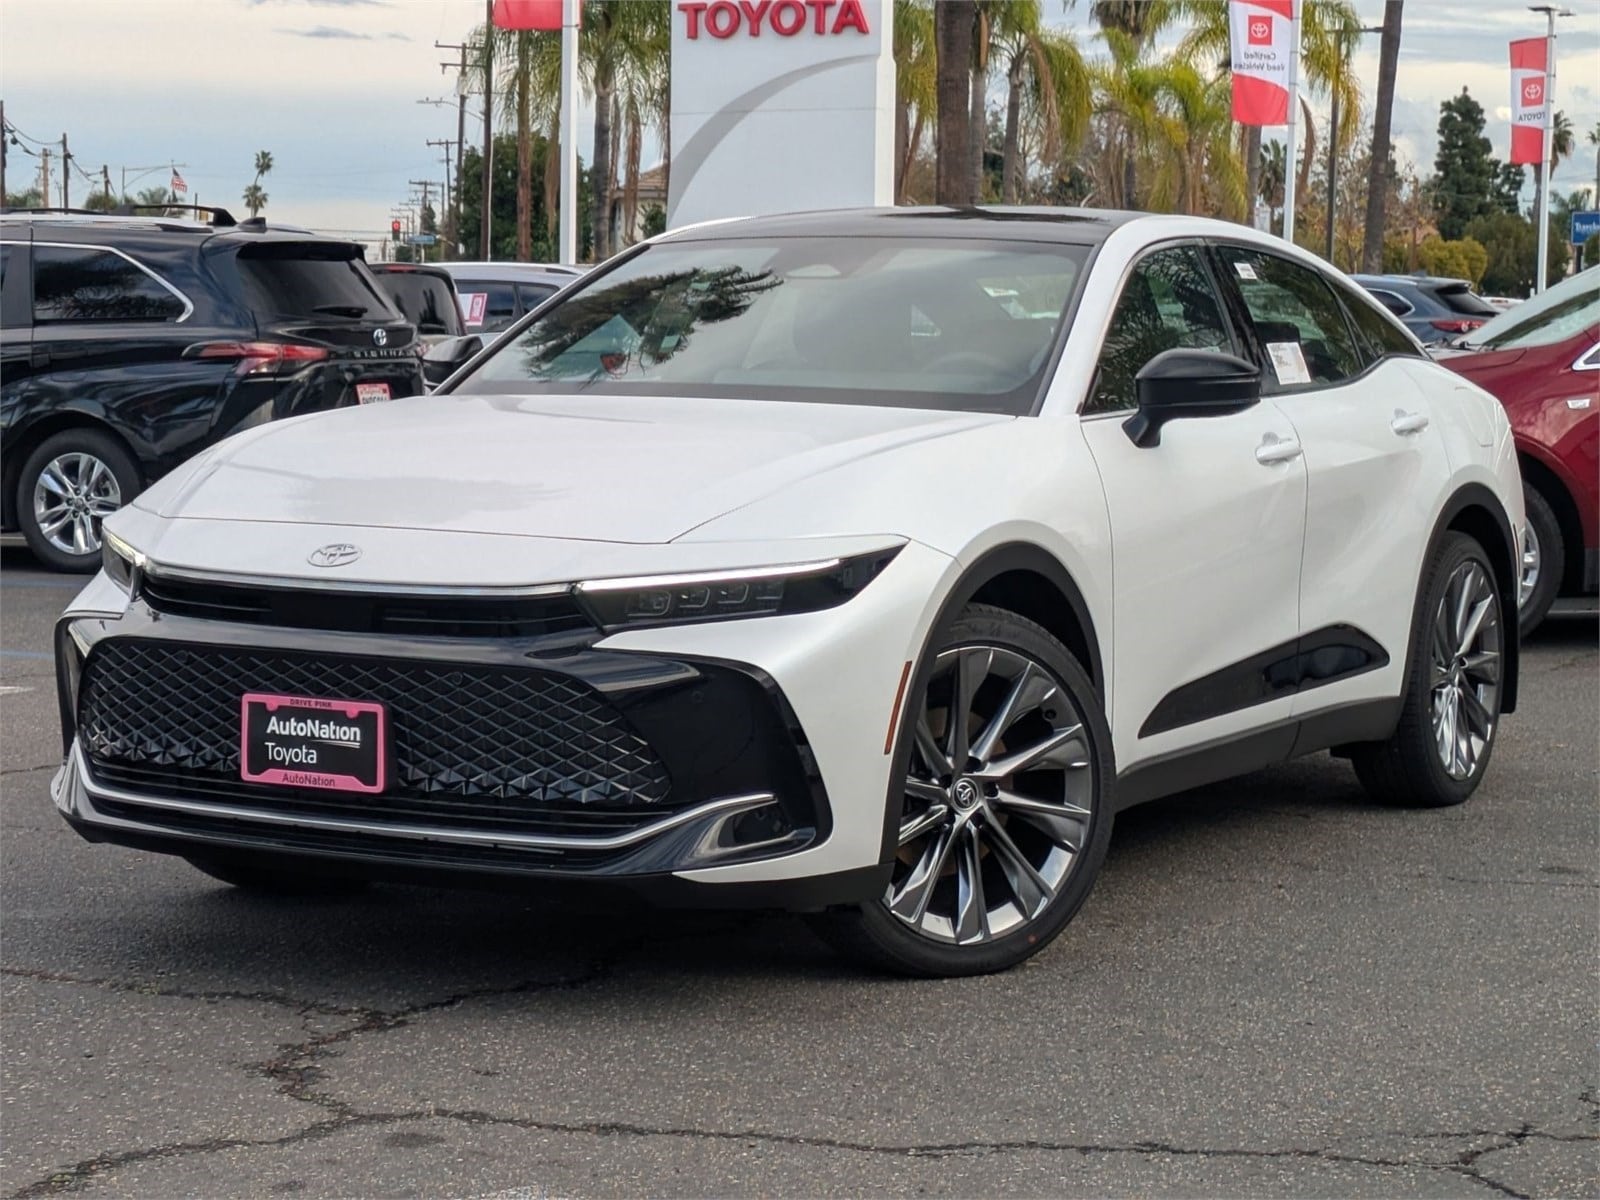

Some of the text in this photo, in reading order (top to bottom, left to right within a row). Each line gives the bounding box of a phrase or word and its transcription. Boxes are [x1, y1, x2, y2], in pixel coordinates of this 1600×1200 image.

[677, 0, 870, 40] TOYOTA
[289, 698, 333, 708] DRIVE PINK
[266, 715, 361, 742] AutoNation
[264, 741, 318, 766] Toyota
[282, 772, 336, 787] AutoNation
